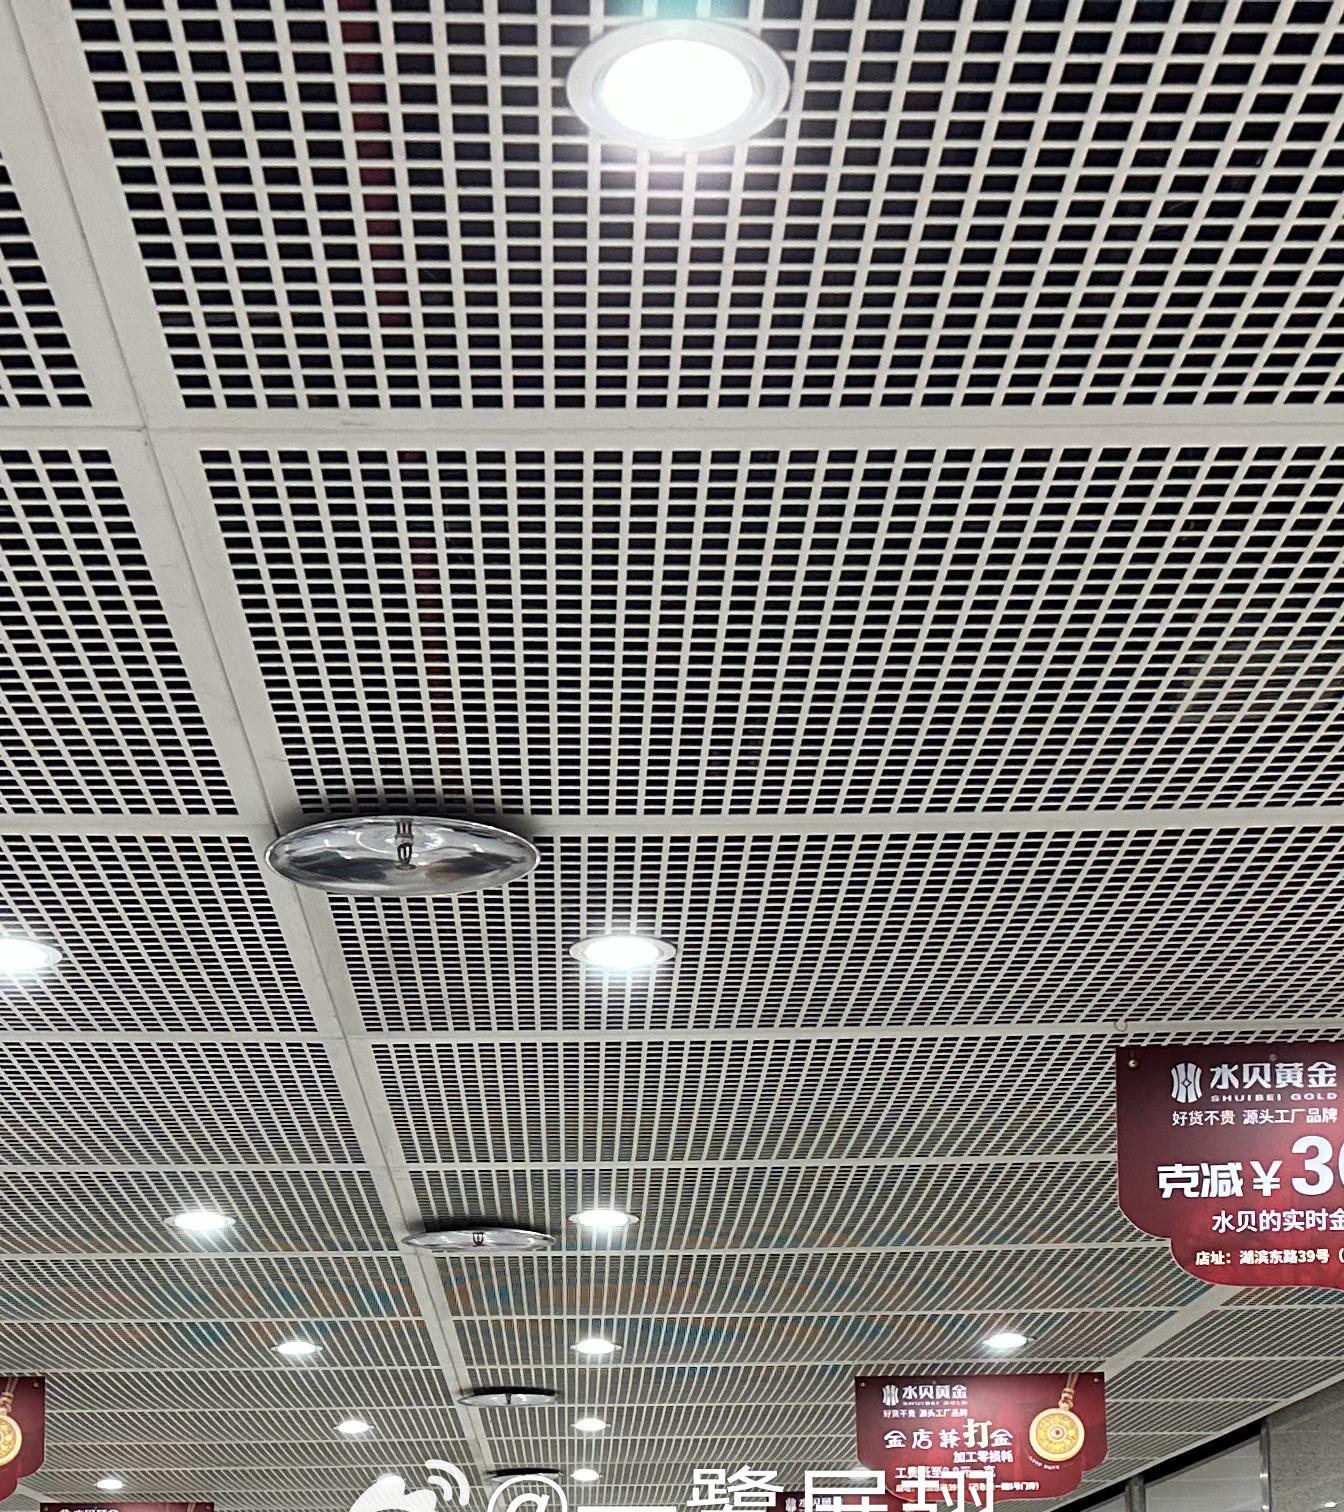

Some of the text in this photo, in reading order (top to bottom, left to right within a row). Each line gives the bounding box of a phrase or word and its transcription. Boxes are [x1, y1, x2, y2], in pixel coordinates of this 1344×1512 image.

[1209, 1061, 1337, 1090] 水贝黄金
[1210, 1093, 1338, 1102] SHUIBEI GOLD
[1172, 1107, 1338, 1127] 好货不贵 源头工厂品牌
